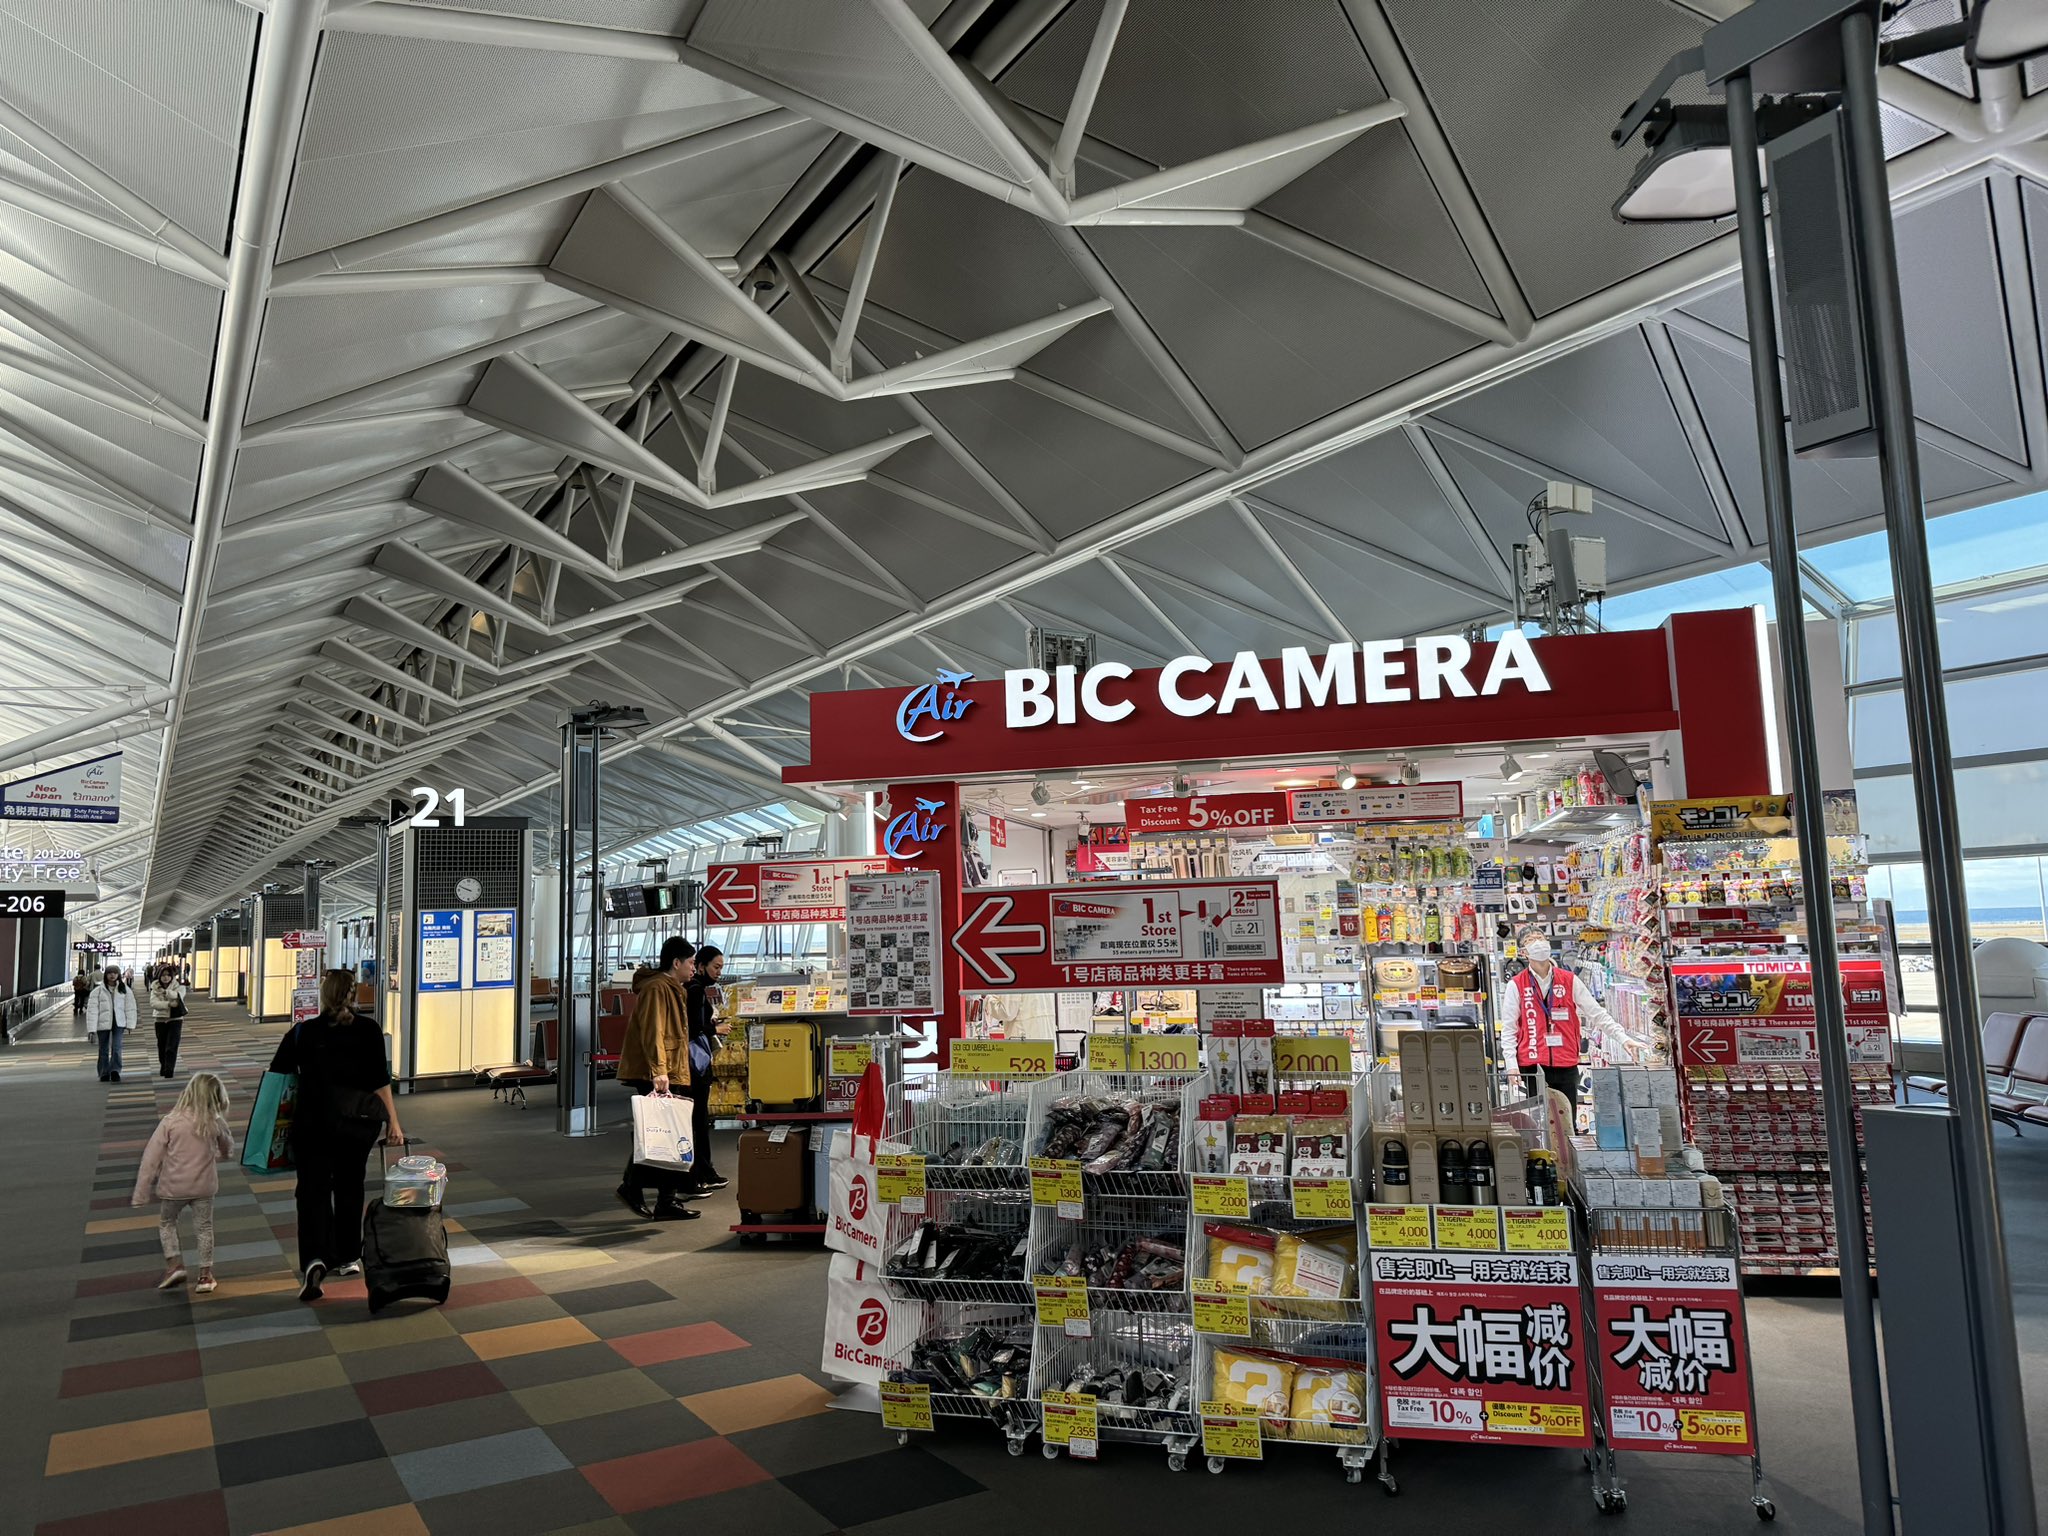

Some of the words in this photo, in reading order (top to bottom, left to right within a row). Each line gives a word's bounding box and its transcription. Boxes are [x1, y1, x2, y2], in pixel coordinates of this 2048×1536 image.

[1004, 662, 1135, 729] BIC
[1157, 628, 1552, 718] CAMERA
[897, 680, 976, 742] Air
[35, 784, 57, 793] Neo
[26, 792, 62, 800] Japan
[4, 805, 72, 819] 免税売店南館
[410, 786, 465, 828] 21
[1140, 806, 1156, 814] Tax
[1158, 805, 1178, 813] Free
[1140, 817, 1181, 827] Discount
[884, 808, 947, 860] Air
[33, 864, 80, 879] Free
[812, 868, 830, 885] 1st
[811, 884, 832, 893] Store
[881, 883, 894, 895] 1st
[1232, 891, 1255, 908] 2nd
[1072, 903, 1086, 913] BIC
[1088, 905, 1115, 916] CAMERA
[1142, 897, 1172, 924] 1st
[849, 912, 929, 926] 1号店商品种类更丰富
[1141, 924, 1177, 937] Store
[1246, 922, 1259, 935] 21
[1061, 963, 1225, 983] 1号店商品种类更丰富
[1746, 961, 1803, 974] TOMICA
[1694, 990, 1762, 1010] モンコレ
[1851, 989, 1881, 1003] トミカ
[1524, 986, 1538, 1060] BicCamera
[1687, 1018, 1767, 1028] 1号店商品种类更丰富
[953, 1056, 967, 1064] Tax
[1009, 1057, 1046, 1072] 528
[907, 1185, 924, 1196] 528
[835, 1214, 878, 1249] BicCamera
[1398, 1226, 1429, 1238] 4,000
[1466, 1228, 1497, 1240] 4,000
[1536, 1229, 1568, 1241] 4,000
[1391, 1306, 1524, 1380] 大幅
[1611, 1306, 1731, 1369] 大幅
[834, 1341, 903, 1372] BicCamera
[1638, 1356, 1708, 1393] 减价
[1467, 1388, 1483, 1398] 할인
[913, 1411, 931, 1421] 700
[1429, 1400, 1473, 1425] 10%
[1492, 1411, 1523, 1419] Discount
[1636, 1410, 1675, 1434] 10%
